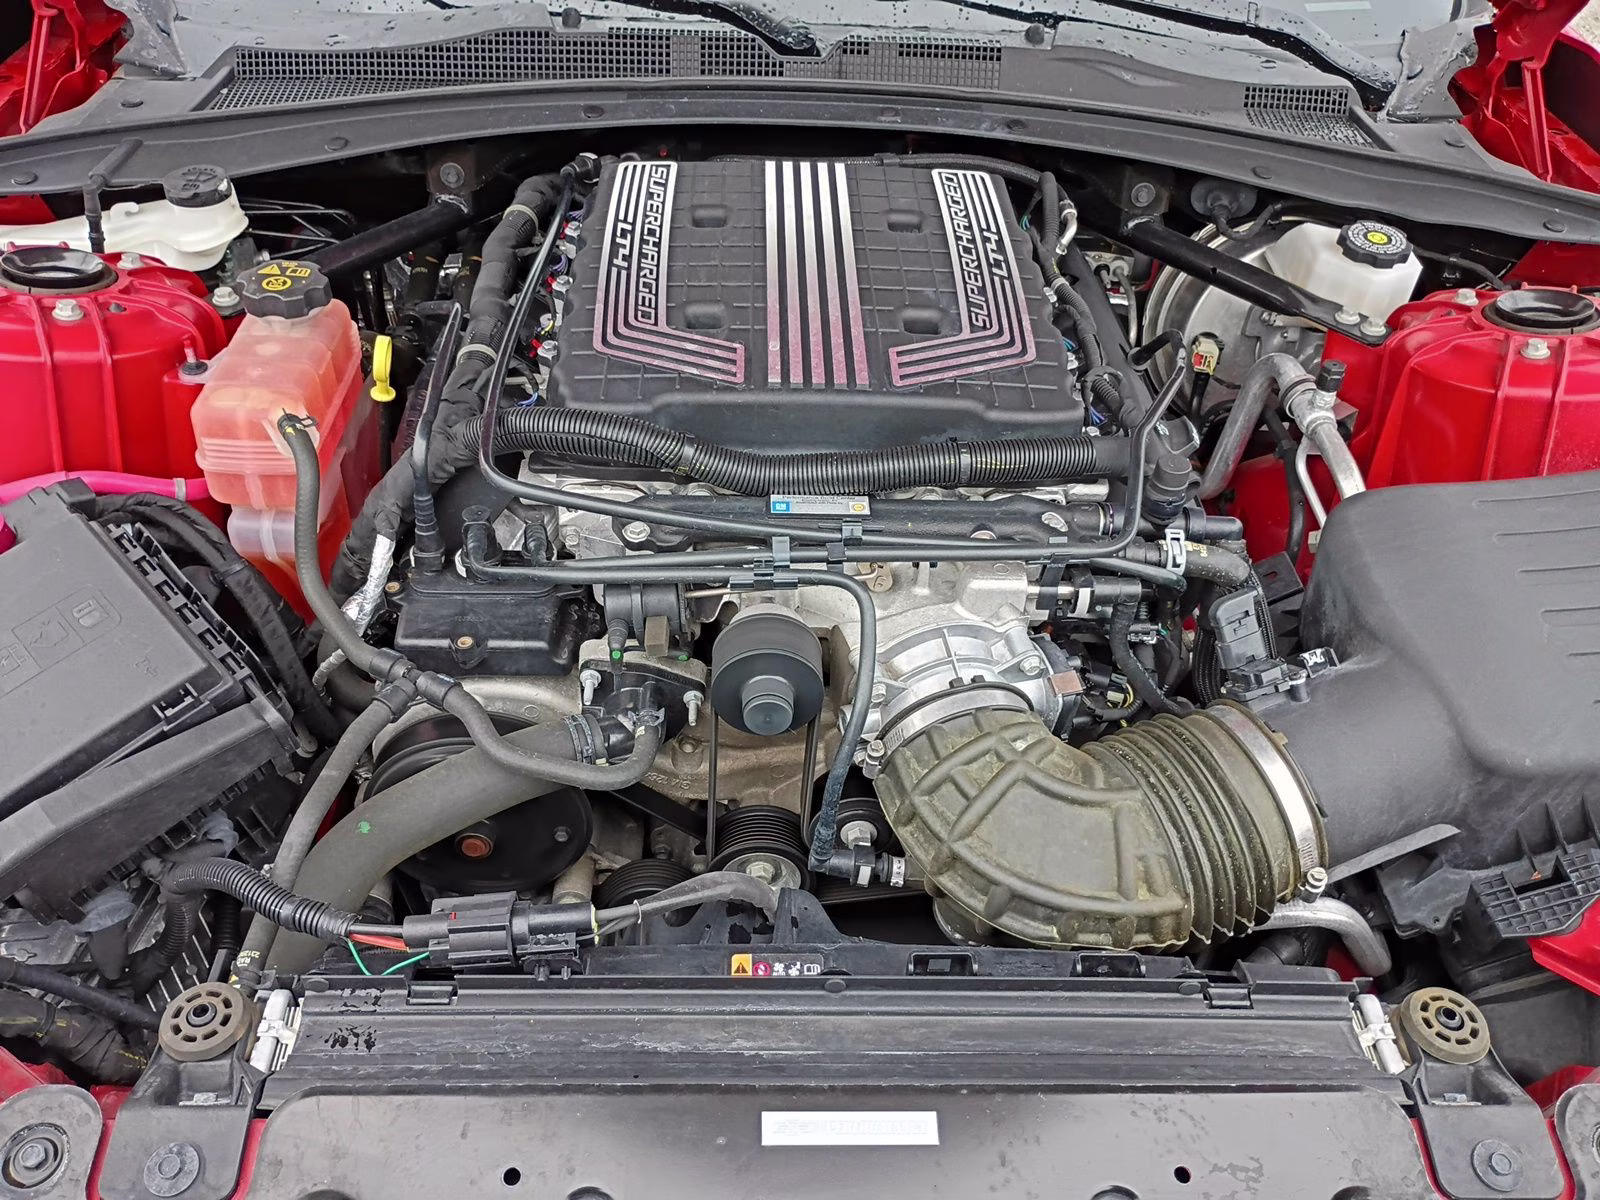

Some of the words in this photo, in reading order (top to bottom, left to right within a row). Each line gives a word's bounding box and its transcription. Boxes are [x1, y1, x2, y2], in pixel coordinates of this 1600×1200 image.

[613, 222, 632, 268] LT4
[637, 166, 667, 325] SUPERCHARGED
[940, 172, 990, 329] SUPERCHARGED
[983, 231, 1009, 278] LT4
